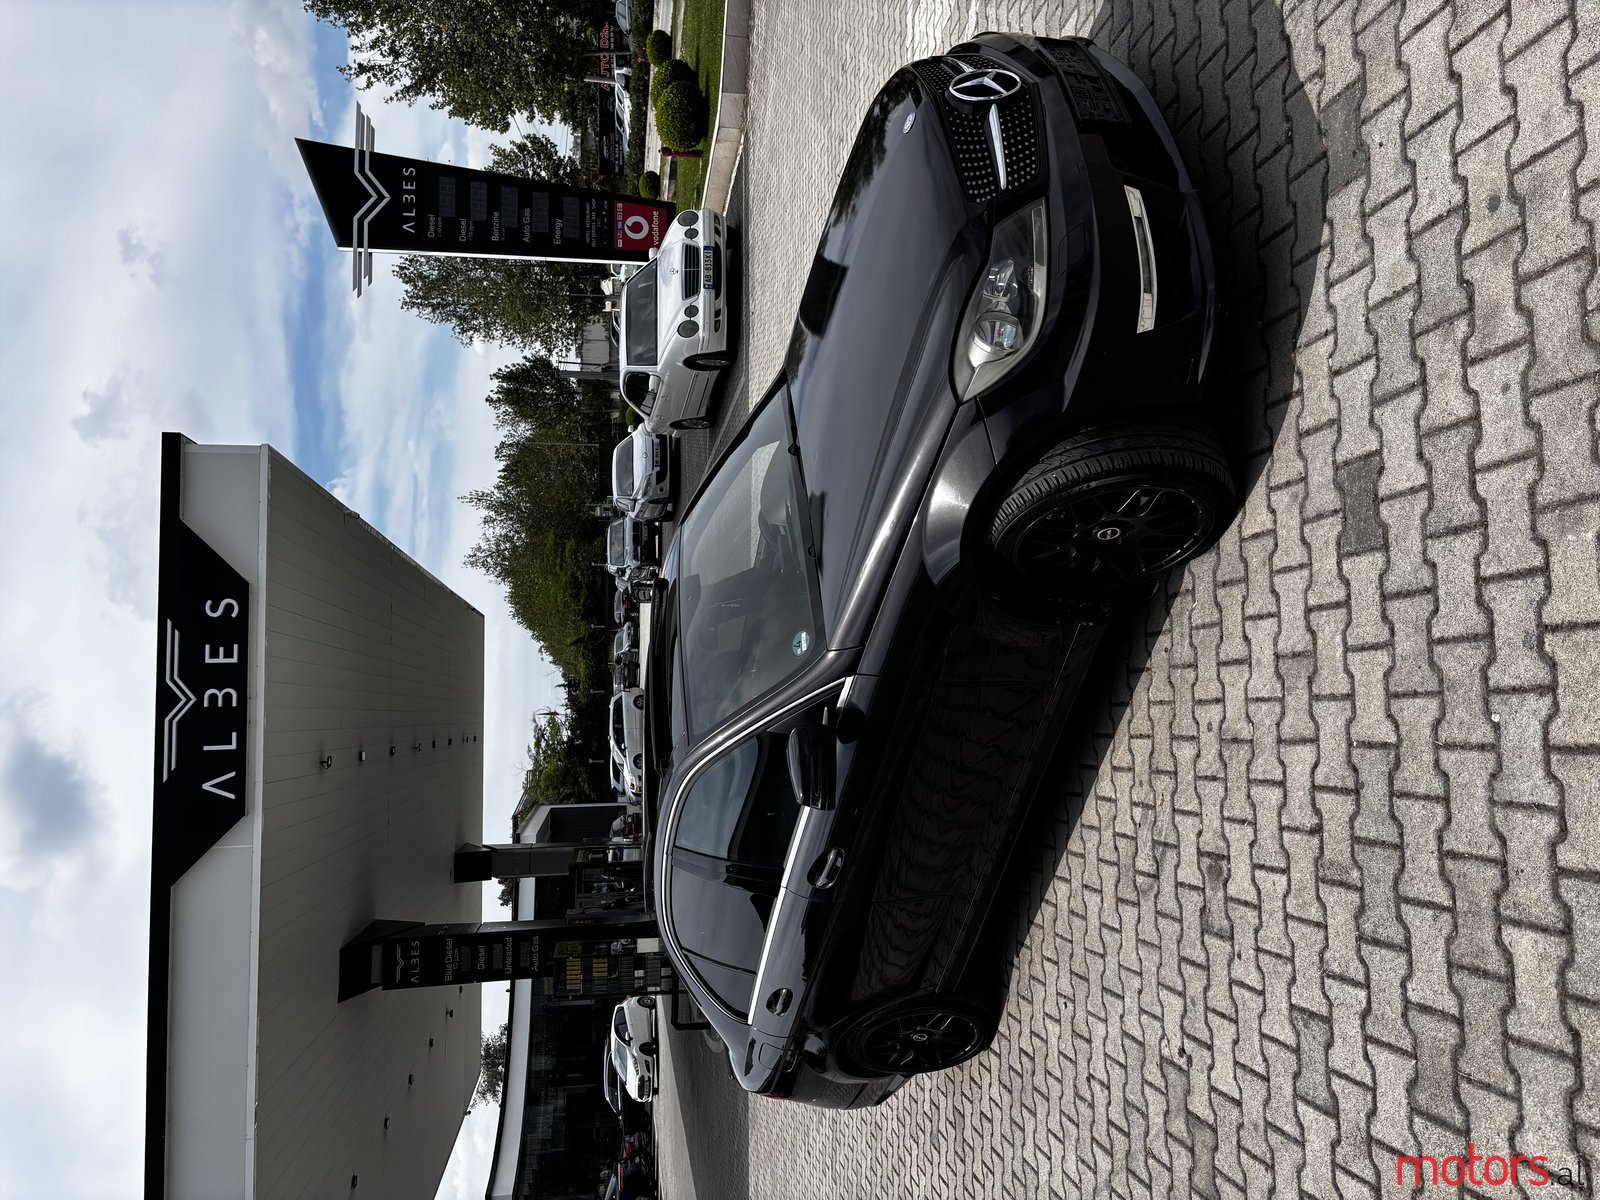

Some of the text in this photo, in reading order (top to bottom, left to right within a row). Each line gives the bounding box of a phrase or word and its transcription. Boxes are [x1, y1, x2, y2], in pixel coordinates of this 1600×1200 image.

[402, 167, 416, 234] ALBES
[428, 214, 436, 238] Diesel
[492, 211, 500, 242] Benzine
[554, 218, 562, 245] Energy
[651, 211, 660, 246] vodafone
[202, 598, 240, 800] ALBES
[504, 937, 512, 974] Unleaded
